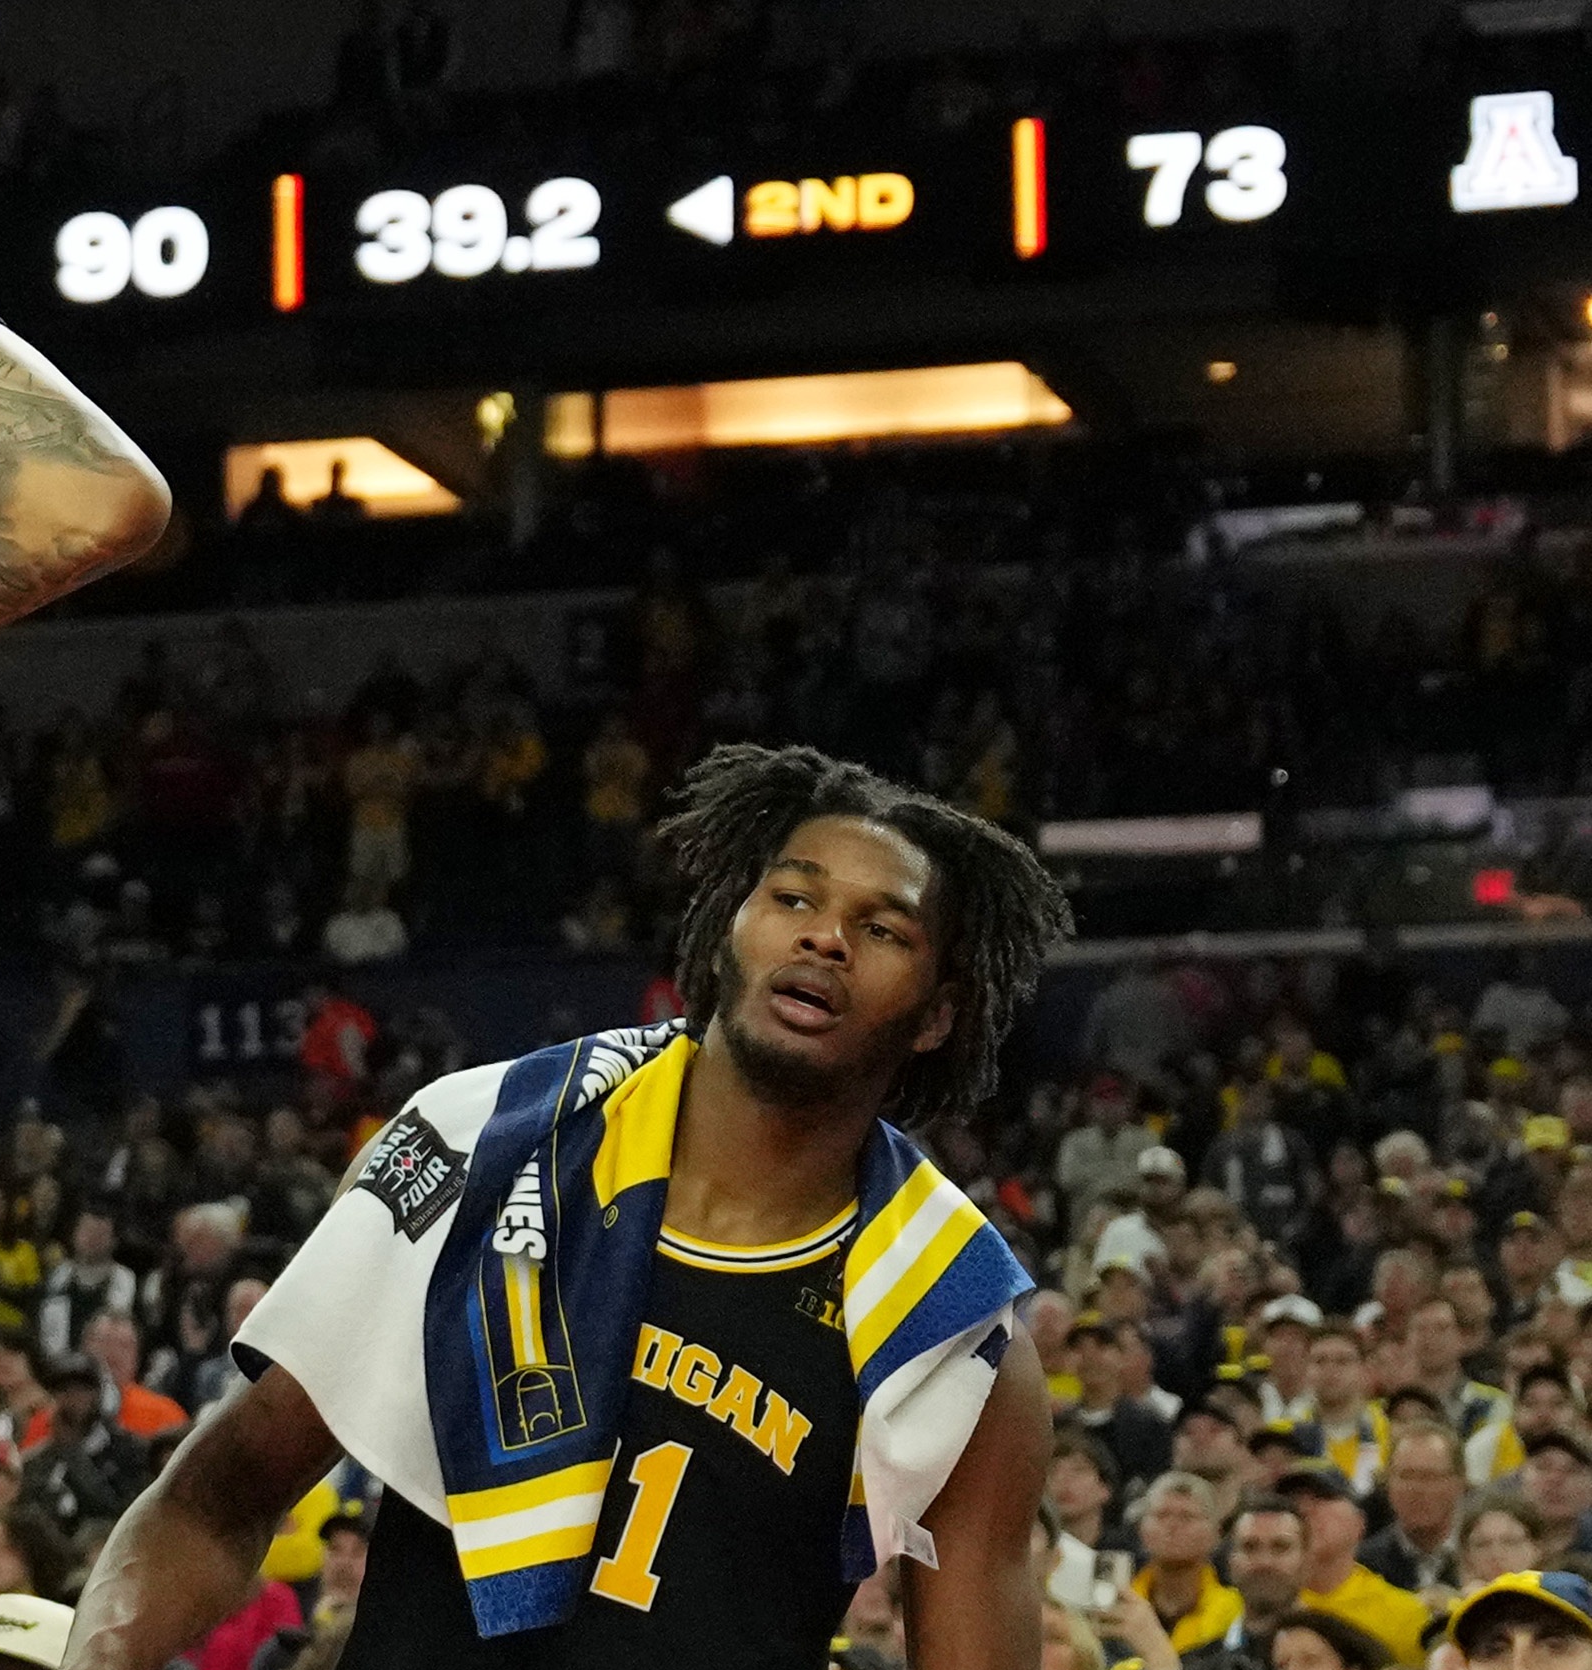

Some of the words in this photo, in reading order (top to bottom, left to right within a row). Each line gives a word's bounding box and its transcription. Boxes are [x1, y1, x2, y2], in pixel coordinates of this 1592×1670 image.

[744, 172, 915, 238] 2ND
[1127, 125, 1288, 228] 73
[55, 206, 210, 302] 90
[355, 176, 603, 283] 39.2
[358, 1123, 418, 1181] FINAL
[398, 1155, 452, 1218] FOUR
[590, 1440, 694, 1613] 1
